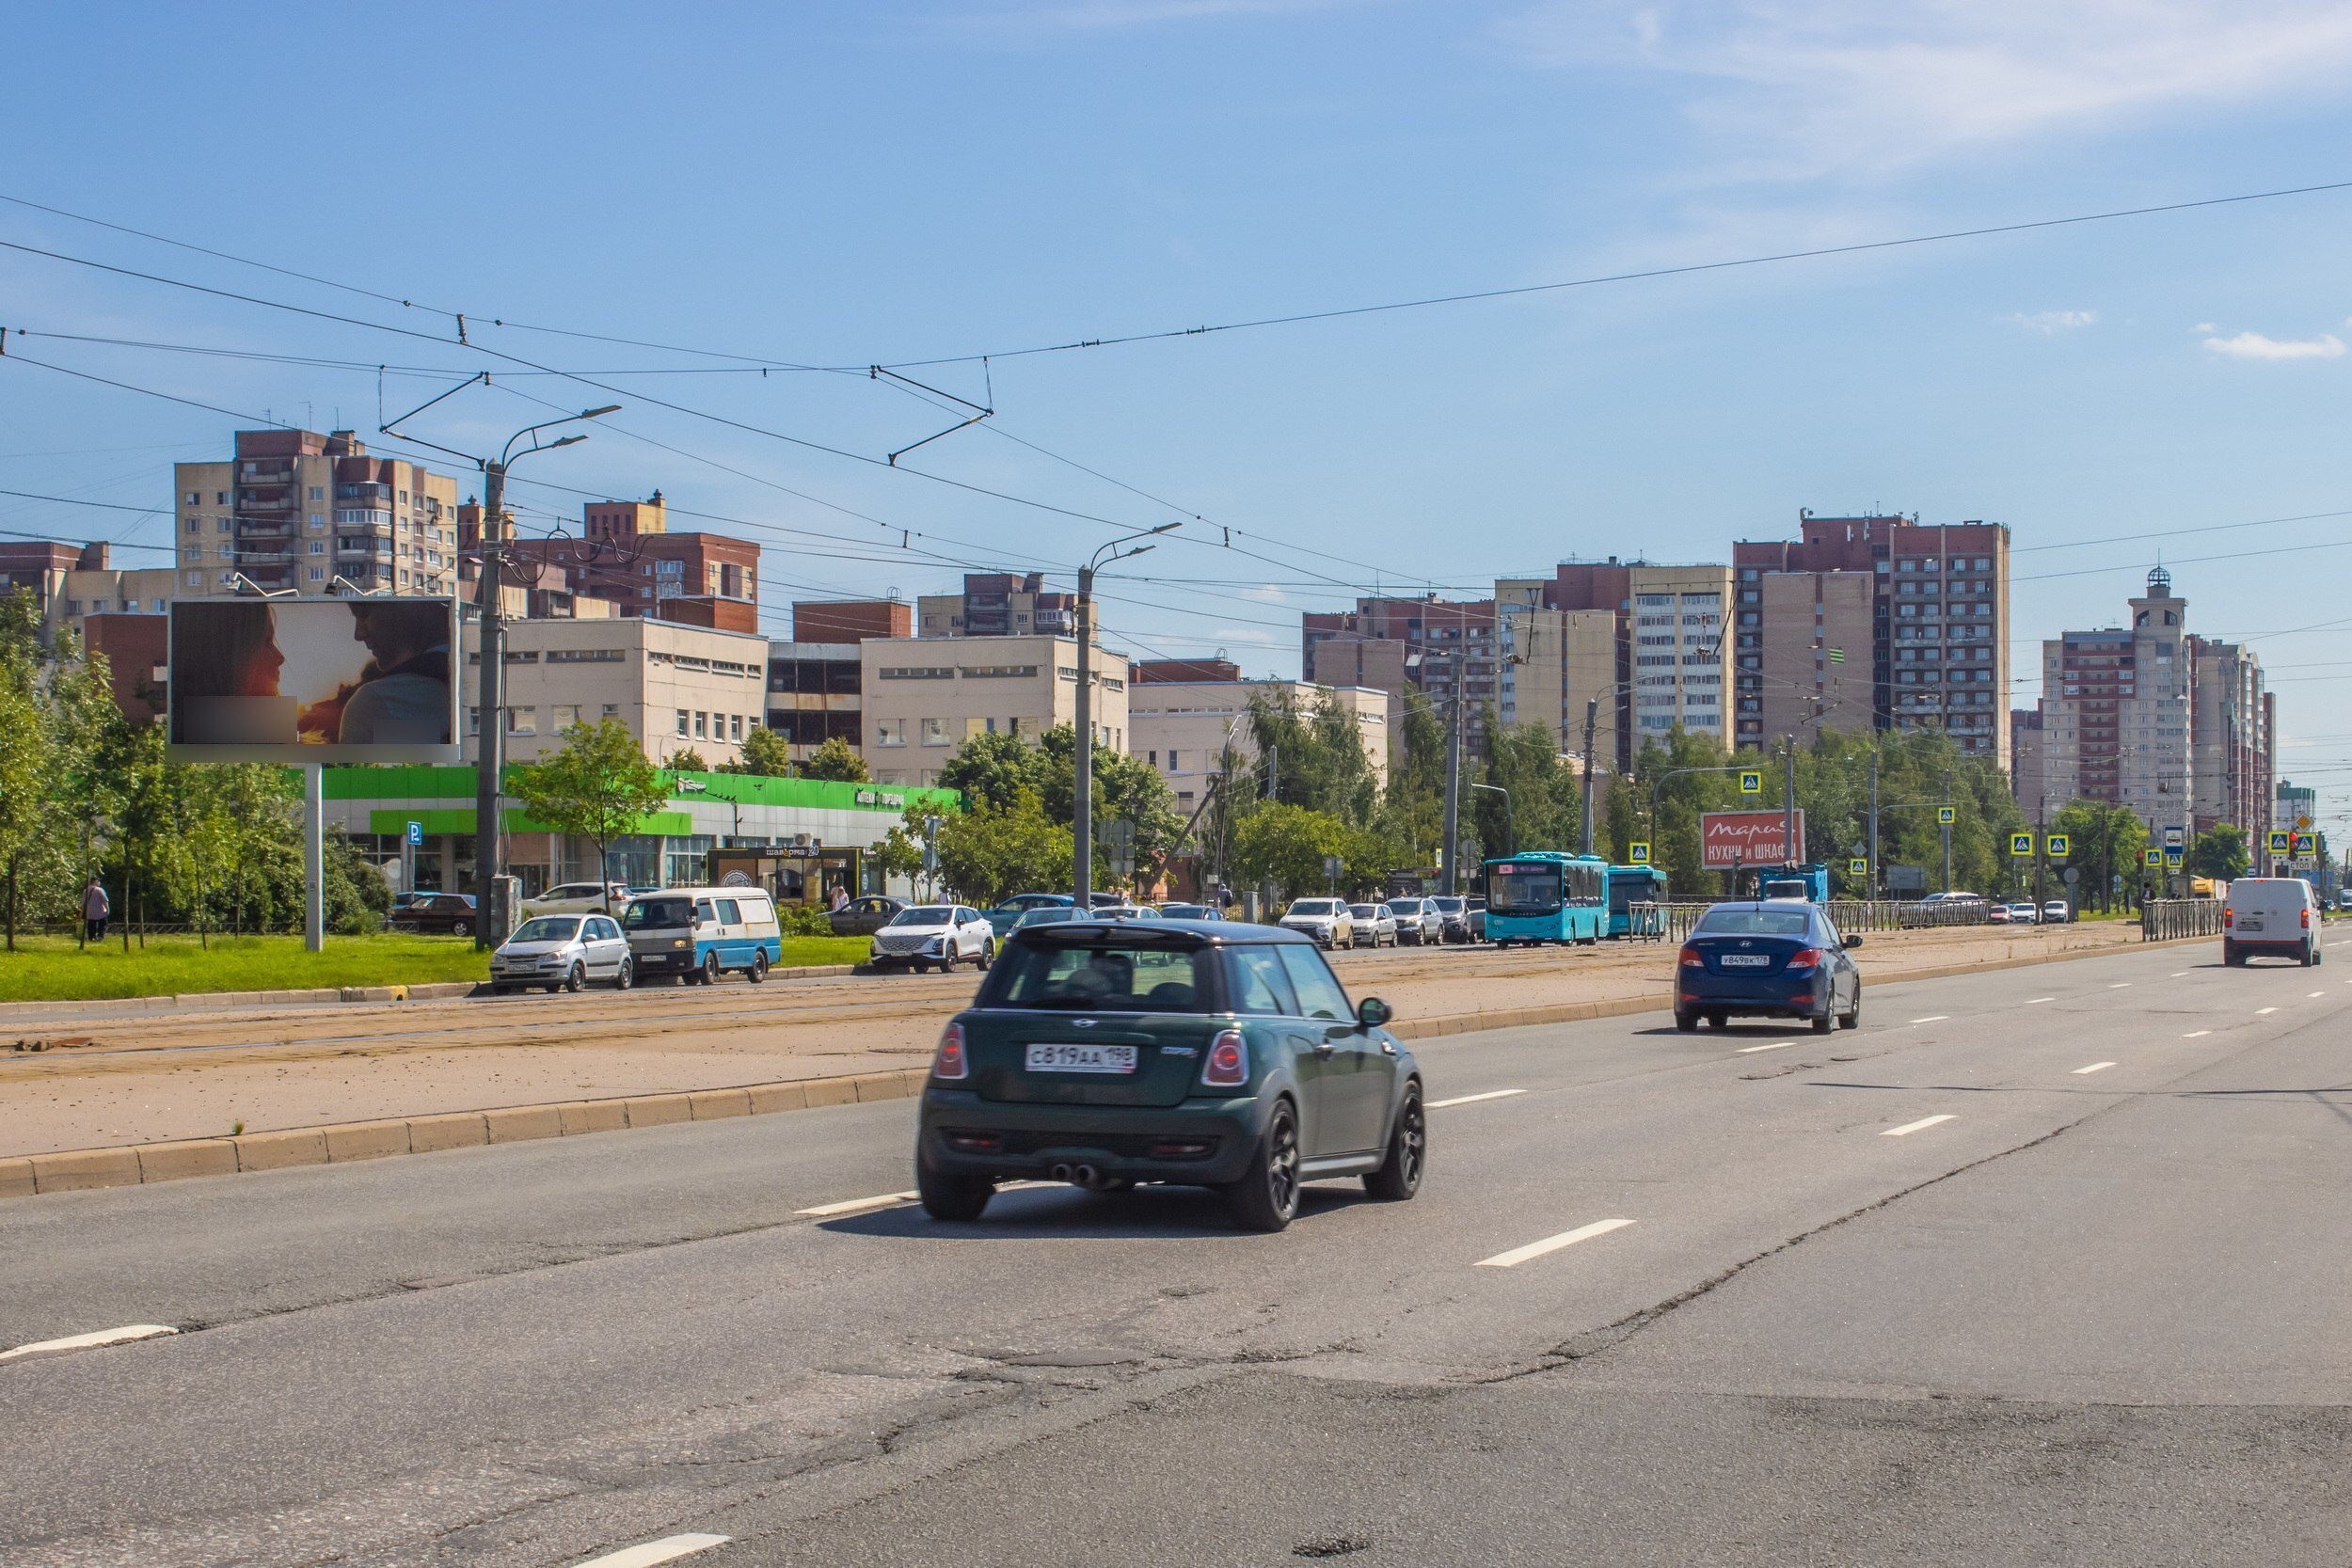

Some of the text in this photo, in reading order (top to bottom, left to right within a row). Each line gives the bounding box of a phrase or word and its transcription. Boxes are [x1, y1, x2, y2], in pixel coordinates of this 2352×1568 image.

[1708, 845, 1741, 860] КУХНИ
[1745, 848, 1751, 859] и
[1031, 1047, 1133, 1065] С819АА 198
